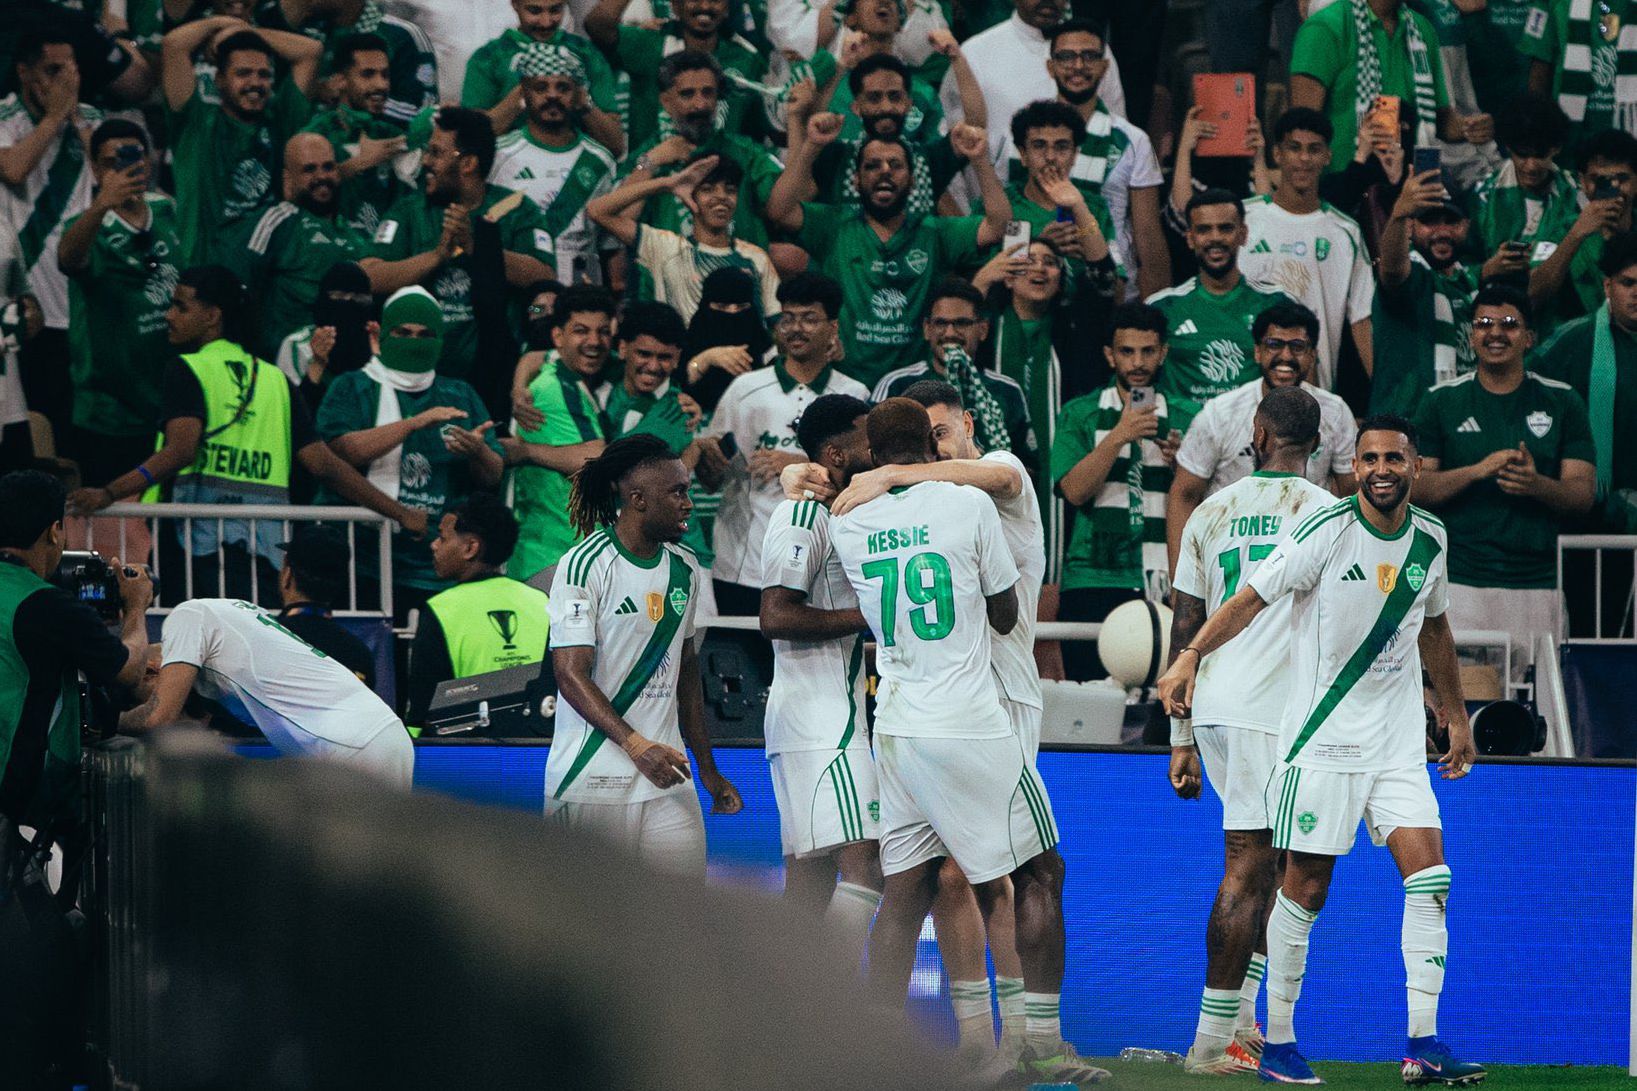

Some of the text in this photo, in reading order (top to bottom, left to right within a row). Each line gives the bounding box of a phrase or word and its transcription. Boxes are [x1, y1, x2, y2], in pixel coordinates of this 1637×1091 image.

[867, 524, 930, 555] KESSIE
[1229, 515, 1283, 538] TONEY
[861, 551, 956, 648] 79
